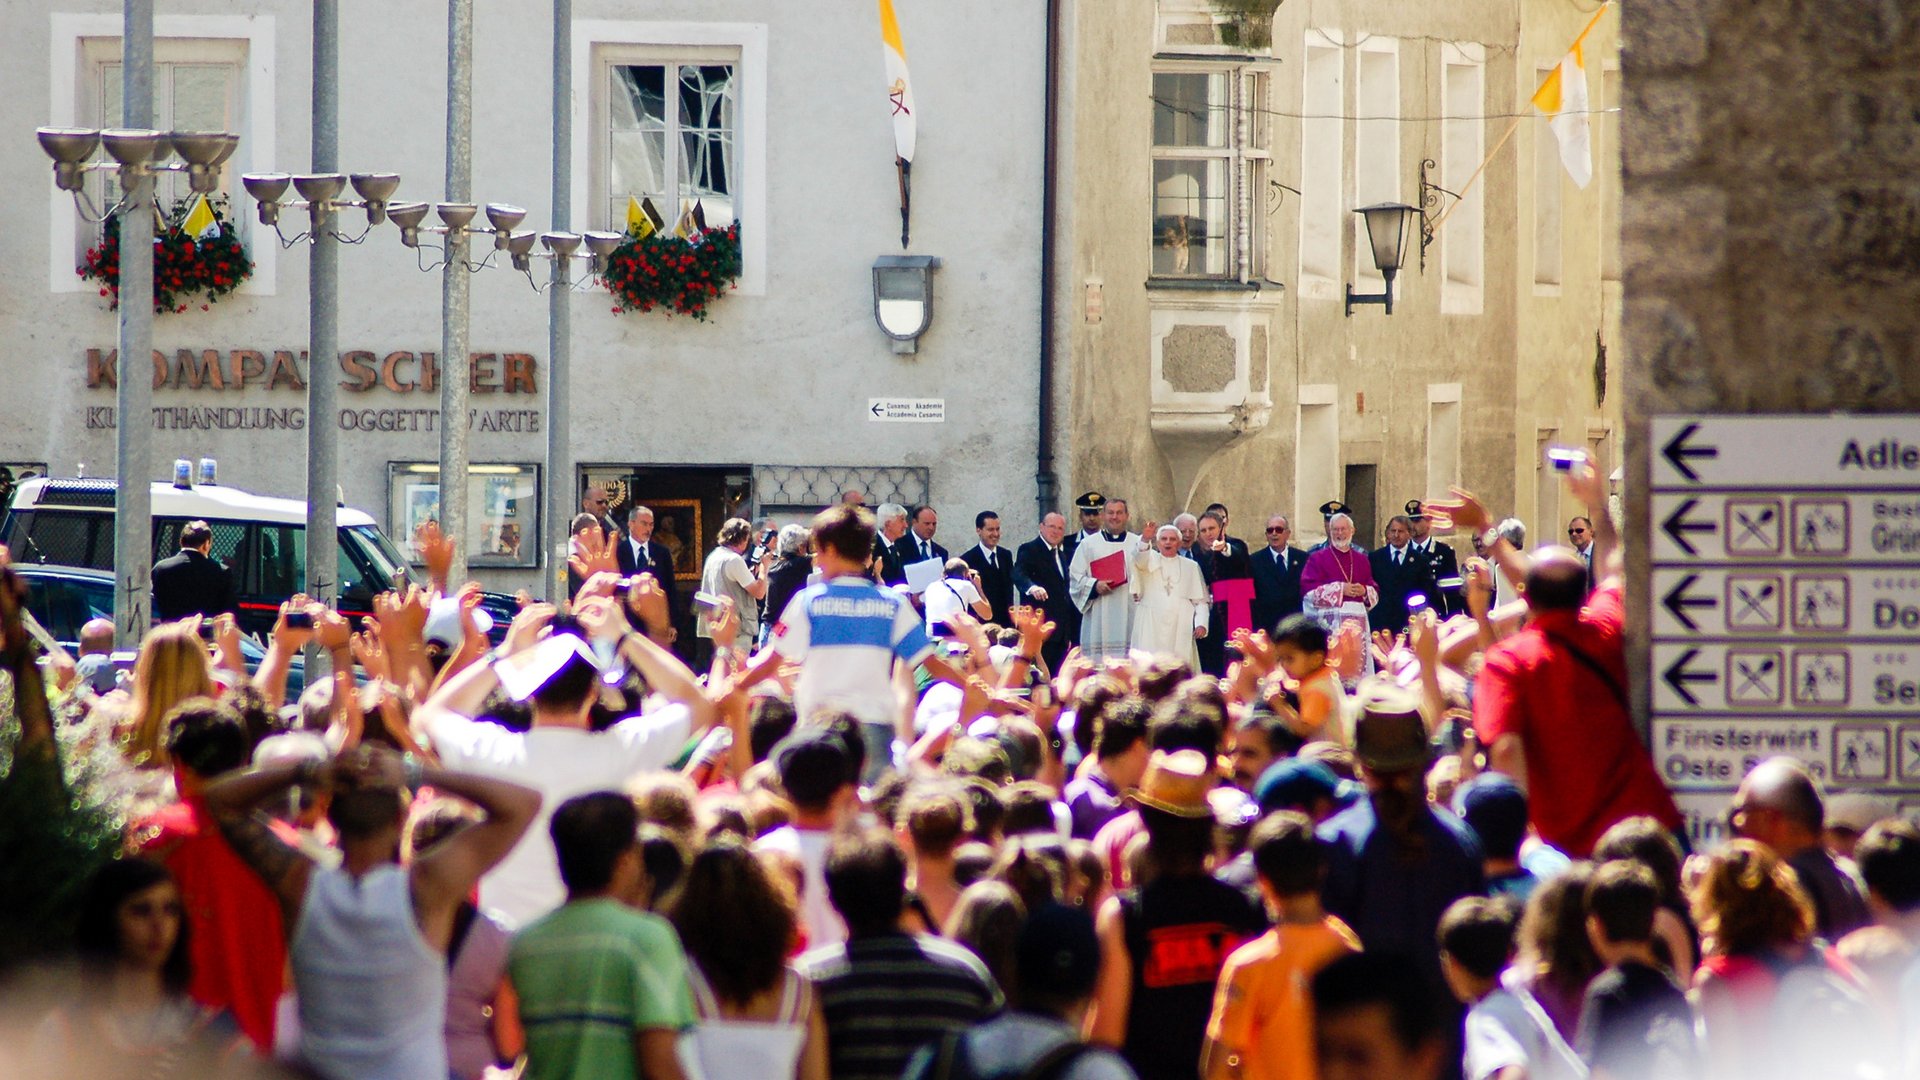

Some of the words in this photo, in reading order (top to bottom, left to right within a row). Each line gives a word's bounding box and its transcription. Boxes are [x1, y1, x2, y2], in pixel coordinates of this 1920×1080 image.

[86, 406, 305, 430] KUTHANDLUNG
[337, 408, 439, 432] OGGETT
[918, 411, 942, 419] Cusanus
[1666, 725, 1819, 749] Finsterwirt
[1666, 754, 1732, 780] Oste
